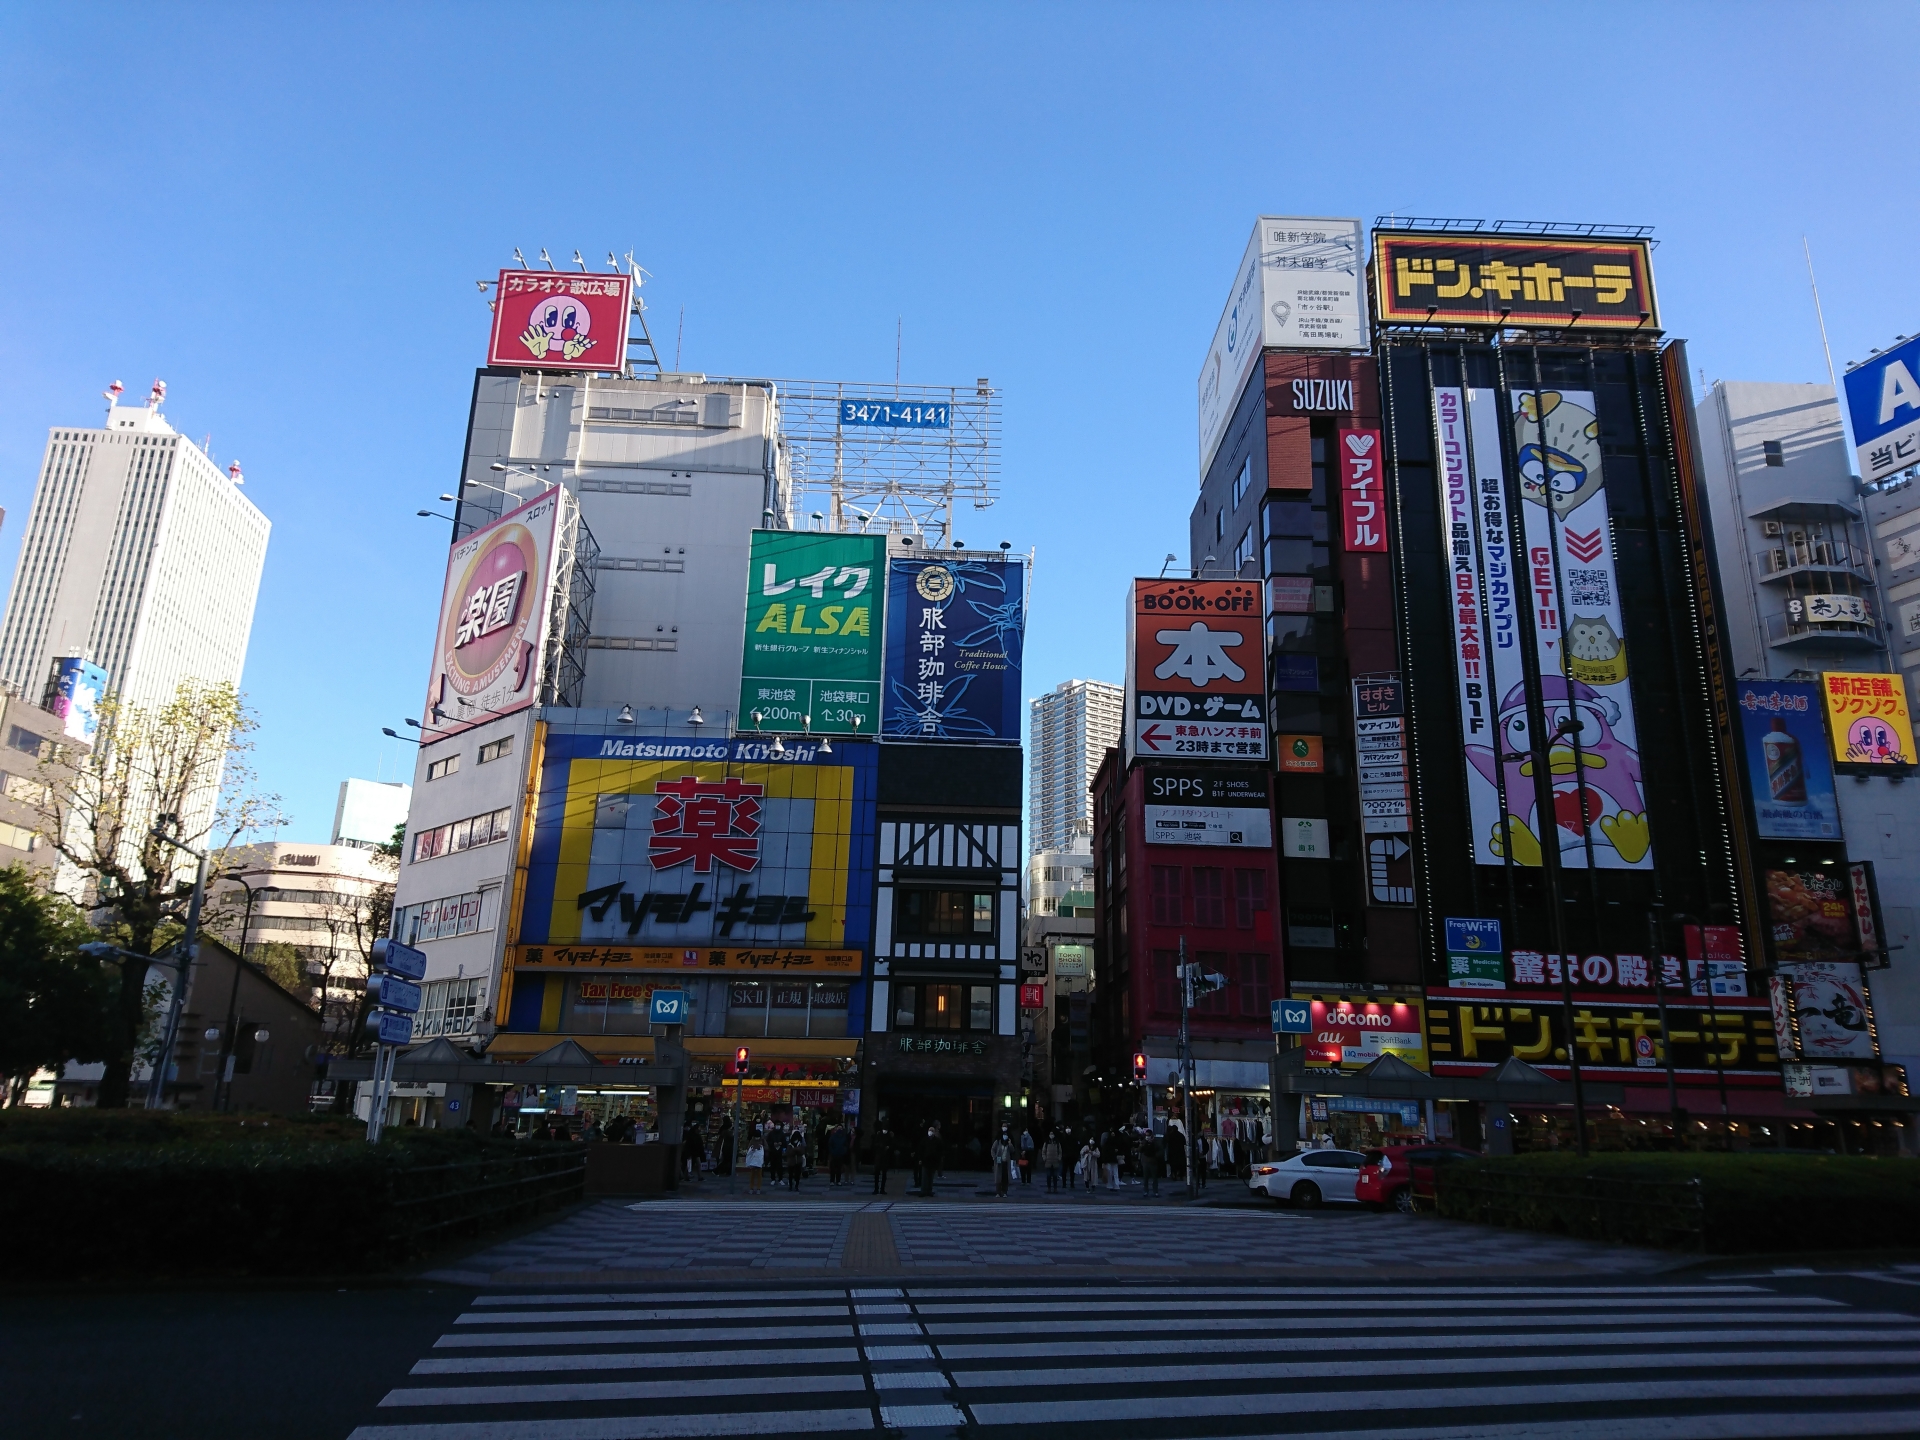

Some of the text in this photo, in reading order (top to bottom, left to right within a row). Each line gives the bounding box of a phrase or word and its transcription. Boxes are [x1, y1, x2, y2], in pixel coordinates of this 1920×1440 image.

[1273, 231, 1327, 243] 唯新学院
[1275, 256, 1328, 269] 芥末留学
[508, 277, 621, 297] カラオケ歌広場
[1292, 379, 1353, 411] SUZUKI
[1879, 359, 1920, 426] A
[845, 404, 947, 423] 3471-4141
[1870, 431, 1920, 472] 当ビ
[1349, 458, 1380, 546] アイフル
[526, 502, 555, 523] スロット
[452, 540, 479, 563] パチンコ
[763, 564, 871, 599] レイク
[454, 570, 526, 649] 楽園
[1789, 599, 1803, 613] 8
[755, 603, 870, 637] ALSA
[445, 617, 528, 693] EXCITING AMUSEMENT
[754, 643, 869, 655] 新生銀行グループ 新生フィナンシャル
[959, 649, 1008, 659] Traditional
[1154, 621, 1246, 687] 本
[917, 607, 947, 733] 服部珈琲舎
[954, 660, 1008, 671] Coffee House
[757, 688, 796, 701] 東池袋
[820, 690, 869, 703] 池袋東口
[1360, 687, 1395, 701] すずき
[762, 707, 802, 720] 200m
[1367, 703, 1390, 712] ビル
[1175, 725, 1262, 739] 東急ハンズ手前
[1368, 721, 1400, 730] アイフル
[600, 739, 815, 762] Matsumoto KiYoshi
[1175, 740, 1262, 755] 23時まで営業
[1363, 753, 1400, 761] アパマンショップ
[1152, 777, 1204, 797] SPPS
[1213, 780, 1223, 788] 2F
[648, 776, 764, 873] 薬
[1184, 832, 1202, 840] 池袋
[422, 900, 480, 926] ネイルサロン
[577, 881, 816, 936] マツモトキヨシ
[1466, 921, 1498, 932] Wi-Fi
[525, 948, 543, 964] 薬
[553, 948, 634, 966] マツモトキヨシ
[708, 951, 727, 966] 薬
[736, 951, 815, 968] マツモトキヨシ
[1451, 956, 1470, 974] 薬
[1511, 949, 1686, 989] 驚安の殿堂
[581, 982, 607, 998] Tax
[610, 983, 643, 998] Free
[776, 990, 802, 1005] 正規
[813, 992, 847, 1005] 取扱店
[1326, 1008, 1392, 1026] docomo
[415, 1018, 474, 1035] ネイルサロン
[899, 1037, 987, 1055] 服部珈琲舎
[1317, 1032, 1345, 1044] au
[1380, 1035, 1412, 1045] SoftBank
[449, 1101, 460, 1111] 43
[1495, 1119, 1505, 1128] 42
